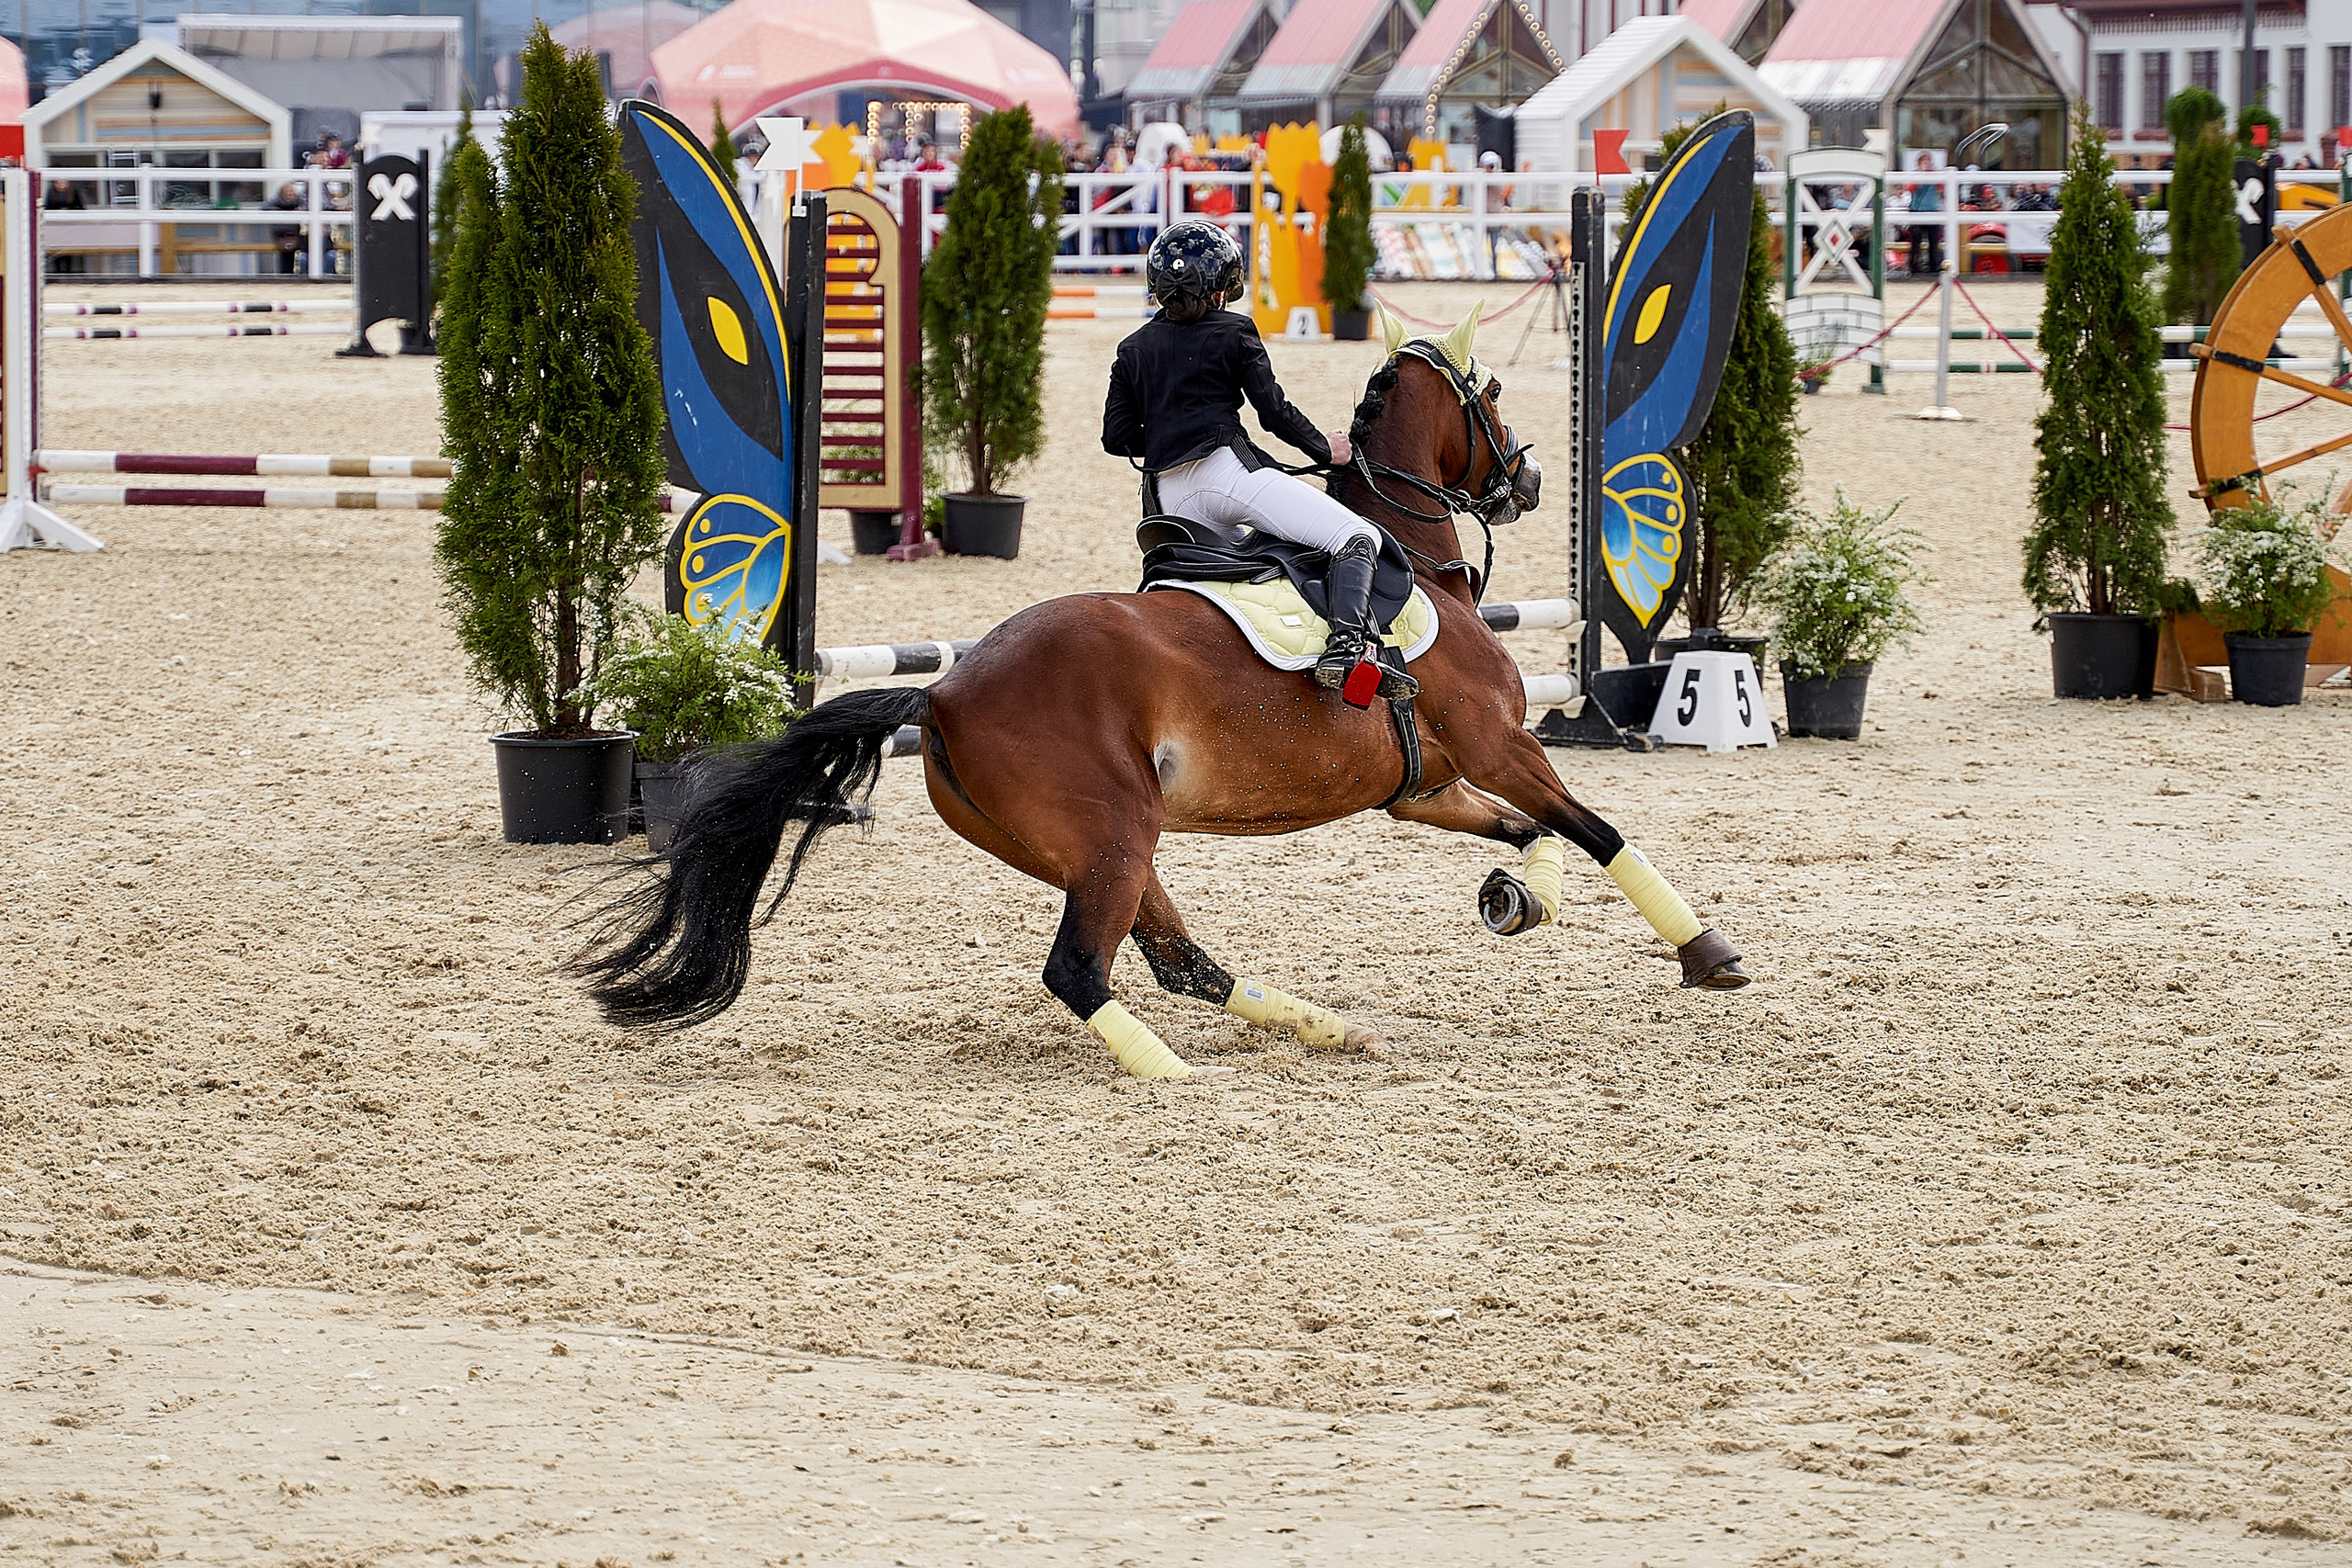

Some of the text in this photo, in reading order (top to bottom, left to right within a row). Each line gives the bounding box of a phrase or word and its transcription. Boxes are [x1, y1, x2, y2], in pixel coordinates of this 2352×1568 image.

[1297, 314, 1308, 335] 2
[1678, 669, 1702, 727] 5
[1734, 670, 1752, 728] 5
